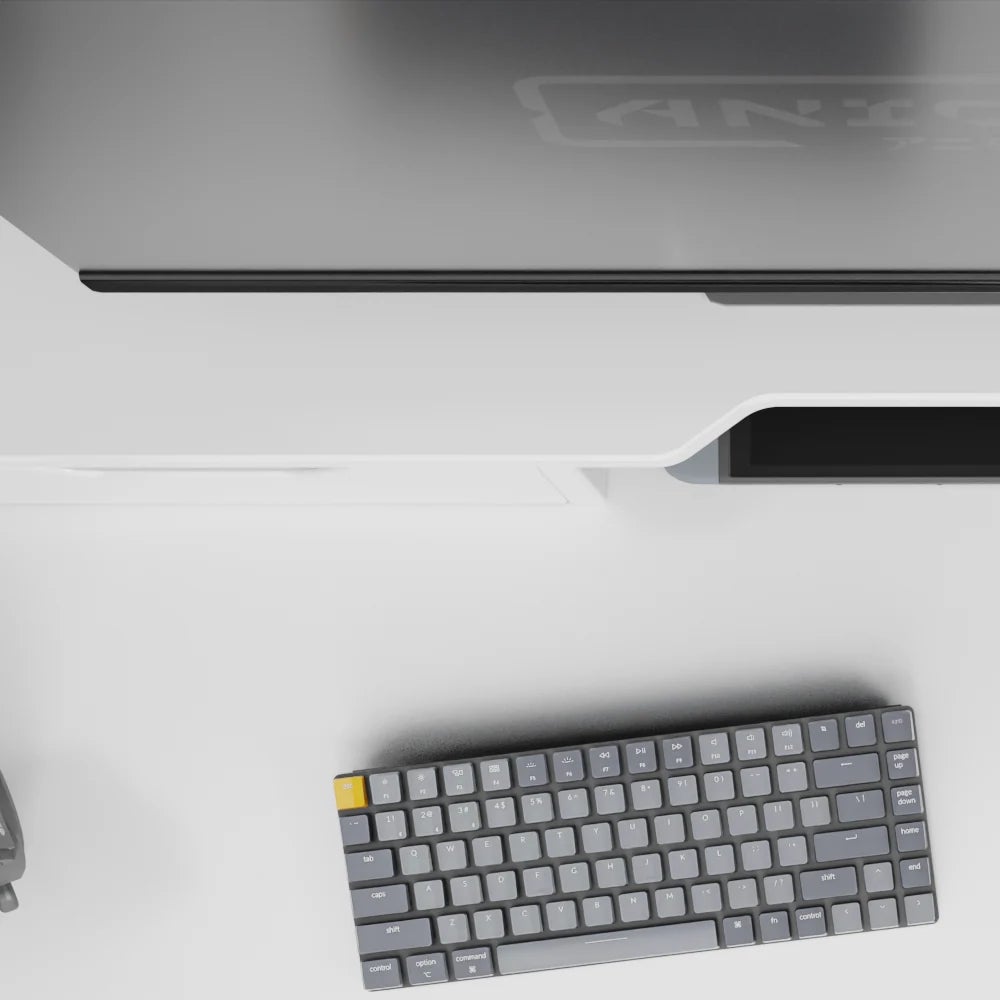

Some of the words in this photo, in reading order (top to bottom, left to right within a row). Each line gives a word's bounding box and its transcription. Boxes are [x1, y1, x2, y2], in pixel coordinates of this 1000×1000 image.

[893, 752, 910, 761] page
[894, 762, 904, 770] up
[896, 789, 912, 797] page
[897, 797, 916, 805] down
[900, 826, 919, 835] home
[363, 855, 374, 863] tab
[908, 862, 921, 871] end
[821, 873, 836, 881] shift
[371, 891, 386, 899] caps
[799, 912, 822, 920] control
[386, 926, 400, 934] shift
[455, 952, 487, 962] command
[415, 958, 437, 968] option
[369, 964, 392, 973] control
